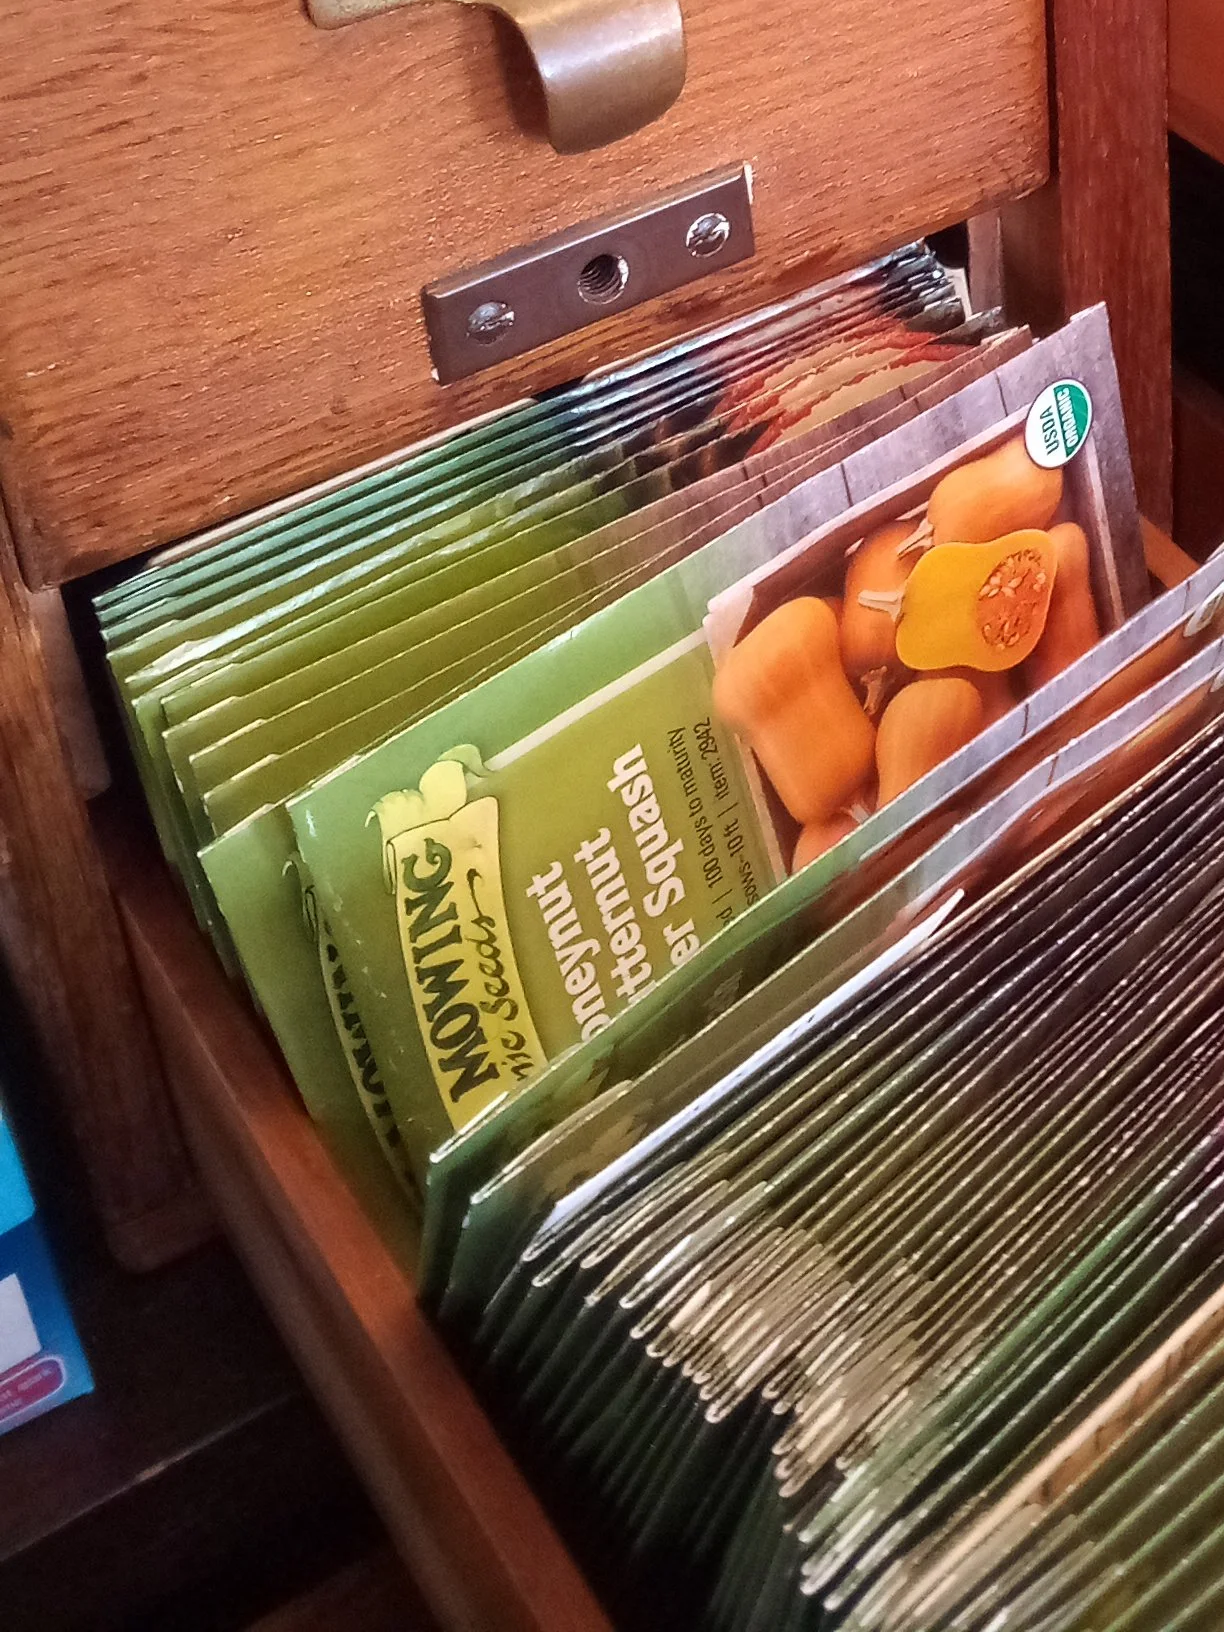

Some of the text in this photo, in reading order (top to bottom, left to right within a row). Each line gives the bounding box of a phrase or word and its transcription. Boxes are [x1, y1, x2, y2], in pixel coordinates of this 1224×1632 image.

[1039, 404, 1060, 456] USDA
[1056, 387, 1080, 449] ORGANIC
[667, 726, 724, 889] 100 days to maturity
[693, 716, 718, 761] 2942
[709, 757, 731, 802] item:
[606, 743, 687, 918] Squash
[723, 818, 739, 838] ft
[401, 837, 501, 1103] MOWING
[465, 867, 519, 1021] Seeds
[526, 861, 613, 1043] oneynut
[574, 827, 657, 1005] tternut
